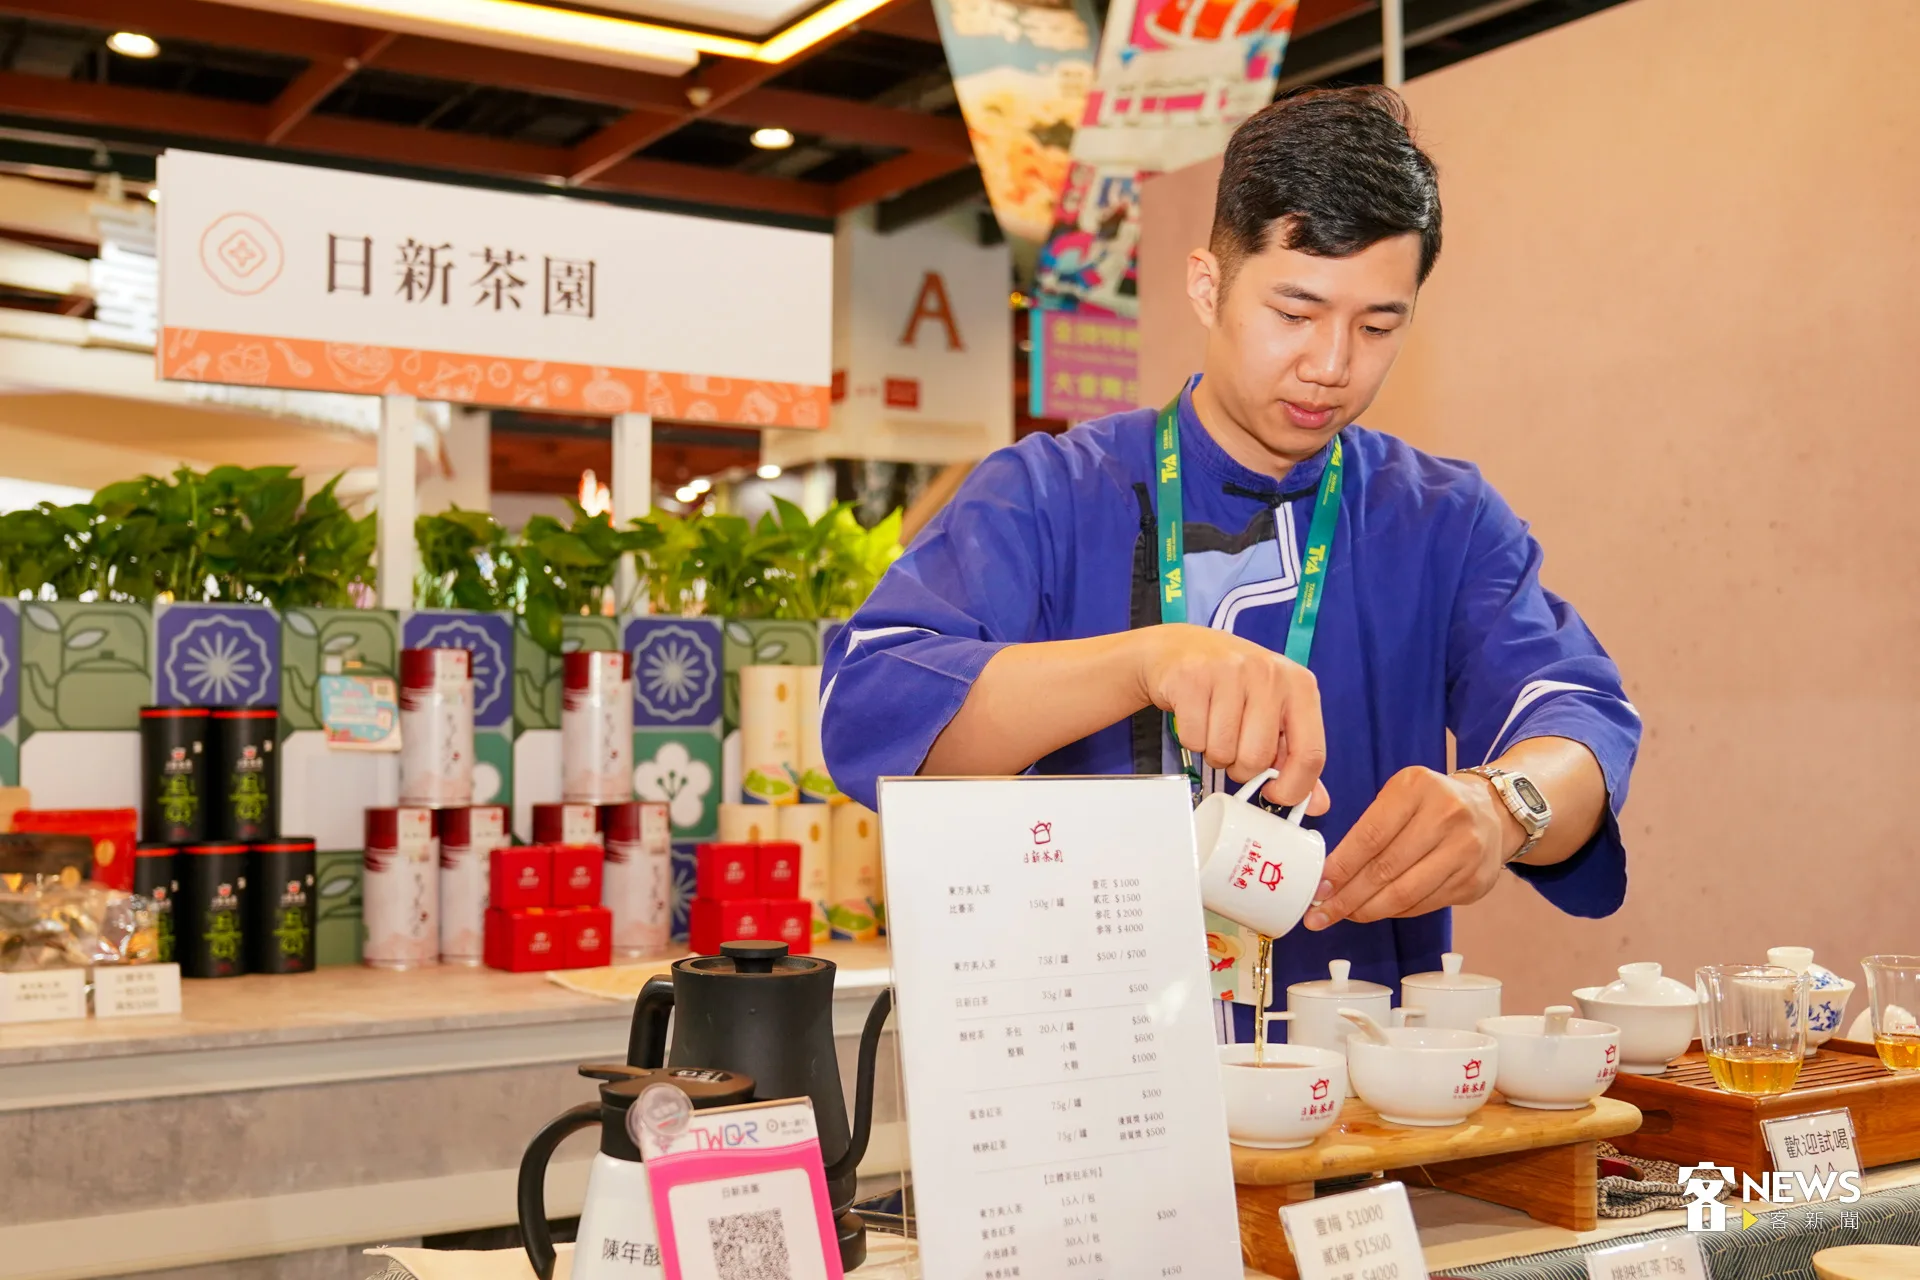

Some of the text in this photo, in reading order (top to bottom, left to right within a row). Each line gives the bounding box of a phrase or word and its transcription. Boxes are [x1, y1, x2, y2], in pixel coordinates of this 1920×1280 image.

[325, 231, 598, 320] 日新茶園
[898, 270, 967, 353] A
[948, 885, 992, 897] 東方美人茶
[1029, 899, 1050, 911] 150g
[953, 959, 996, 972] 東方美人茶
[1783, 1127, 1850, 1159] 歡迎試喝
[979, 1203, 1023, 1219] 東方美人茶
[1663, 1256, 1686, 1275] 75g
